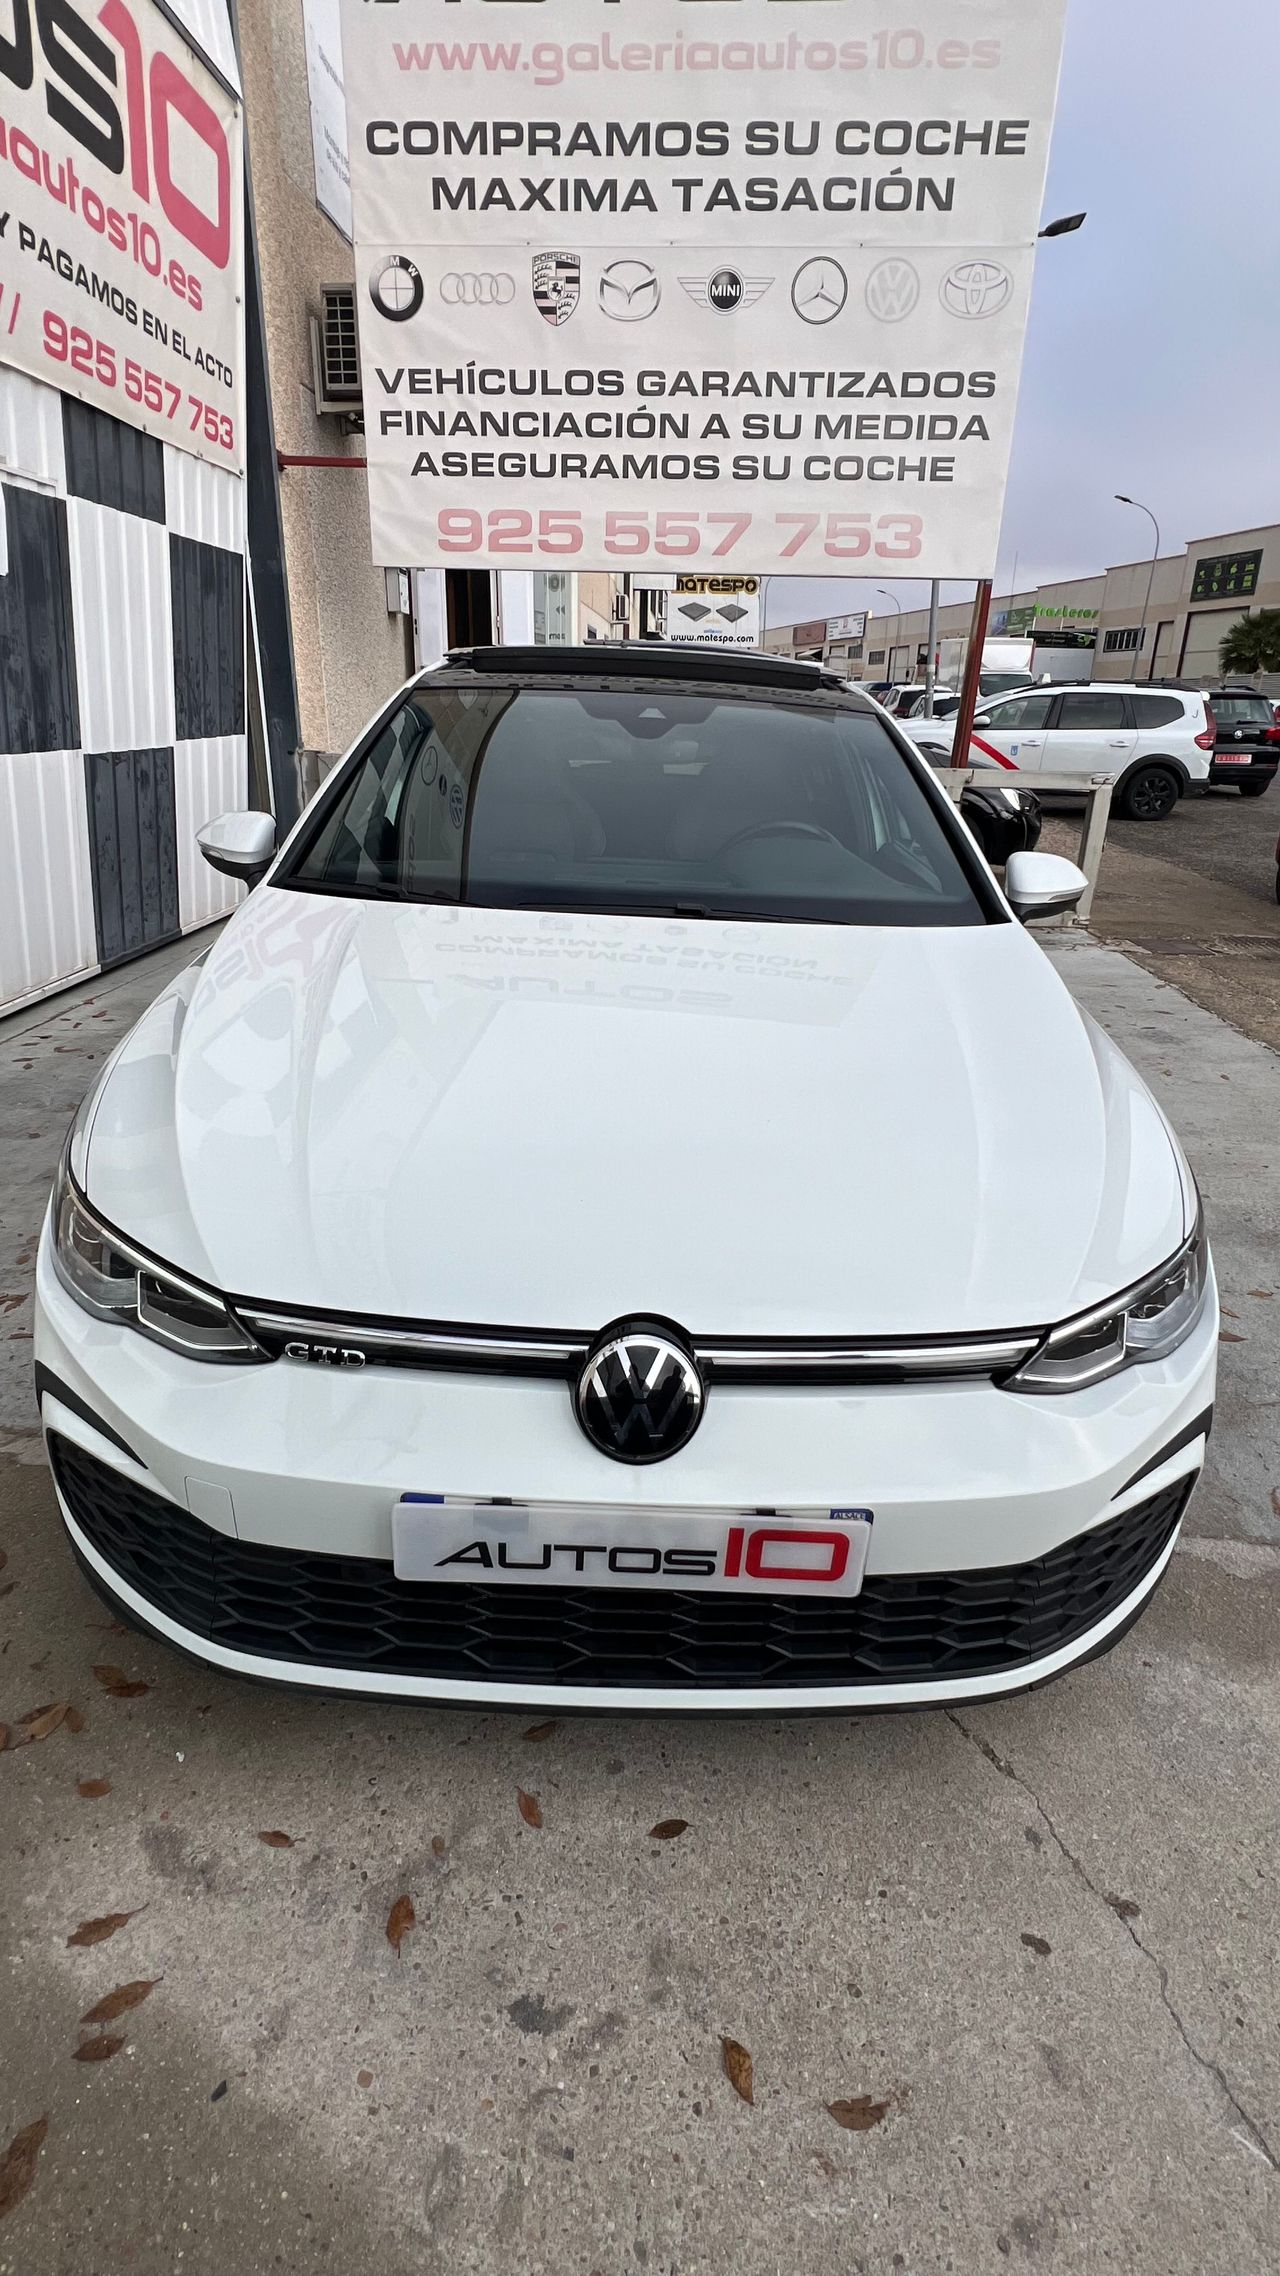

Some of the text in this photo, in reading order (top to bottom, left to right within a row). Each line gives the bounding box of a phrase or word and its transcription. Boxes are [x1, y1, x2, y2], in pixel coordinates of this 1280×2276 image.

[391, 30, 1001, 86] www.galeriaautos10.es
[366, 120, 730, 157] COMPRAMOS
[746, 121, 820, 156] SU
[835, 120, 1030, 156] COCHE
[431, 166, 955, 212] MAXIMA TASACIÓN
[18, 220, 138, 326] PAGAMOS
[142, 308, 168, 346] EN
[172, 328, 191, 361] EL
[195, 347, 233, 389] ACTO
[711, 285, 740, 297] MINI
[43, 309, 116, 388] 925
[124, 357, 182, 419] 557
[188, 394, 234, 450] 753
[375, 360, 997, 399] VEHÍCULOS GARANTIZADOS
[379, 404, 990, 441] FINANCIACIÓN A SU MEDIDA
[410, 451, 956, 482] ASEGURAMOS SU COCHE
[437, 507, 924, 559] 925 557 753
[670, 634, 754, 644] www.matespo.com
[284, 1341, 366, 1369] GTD
